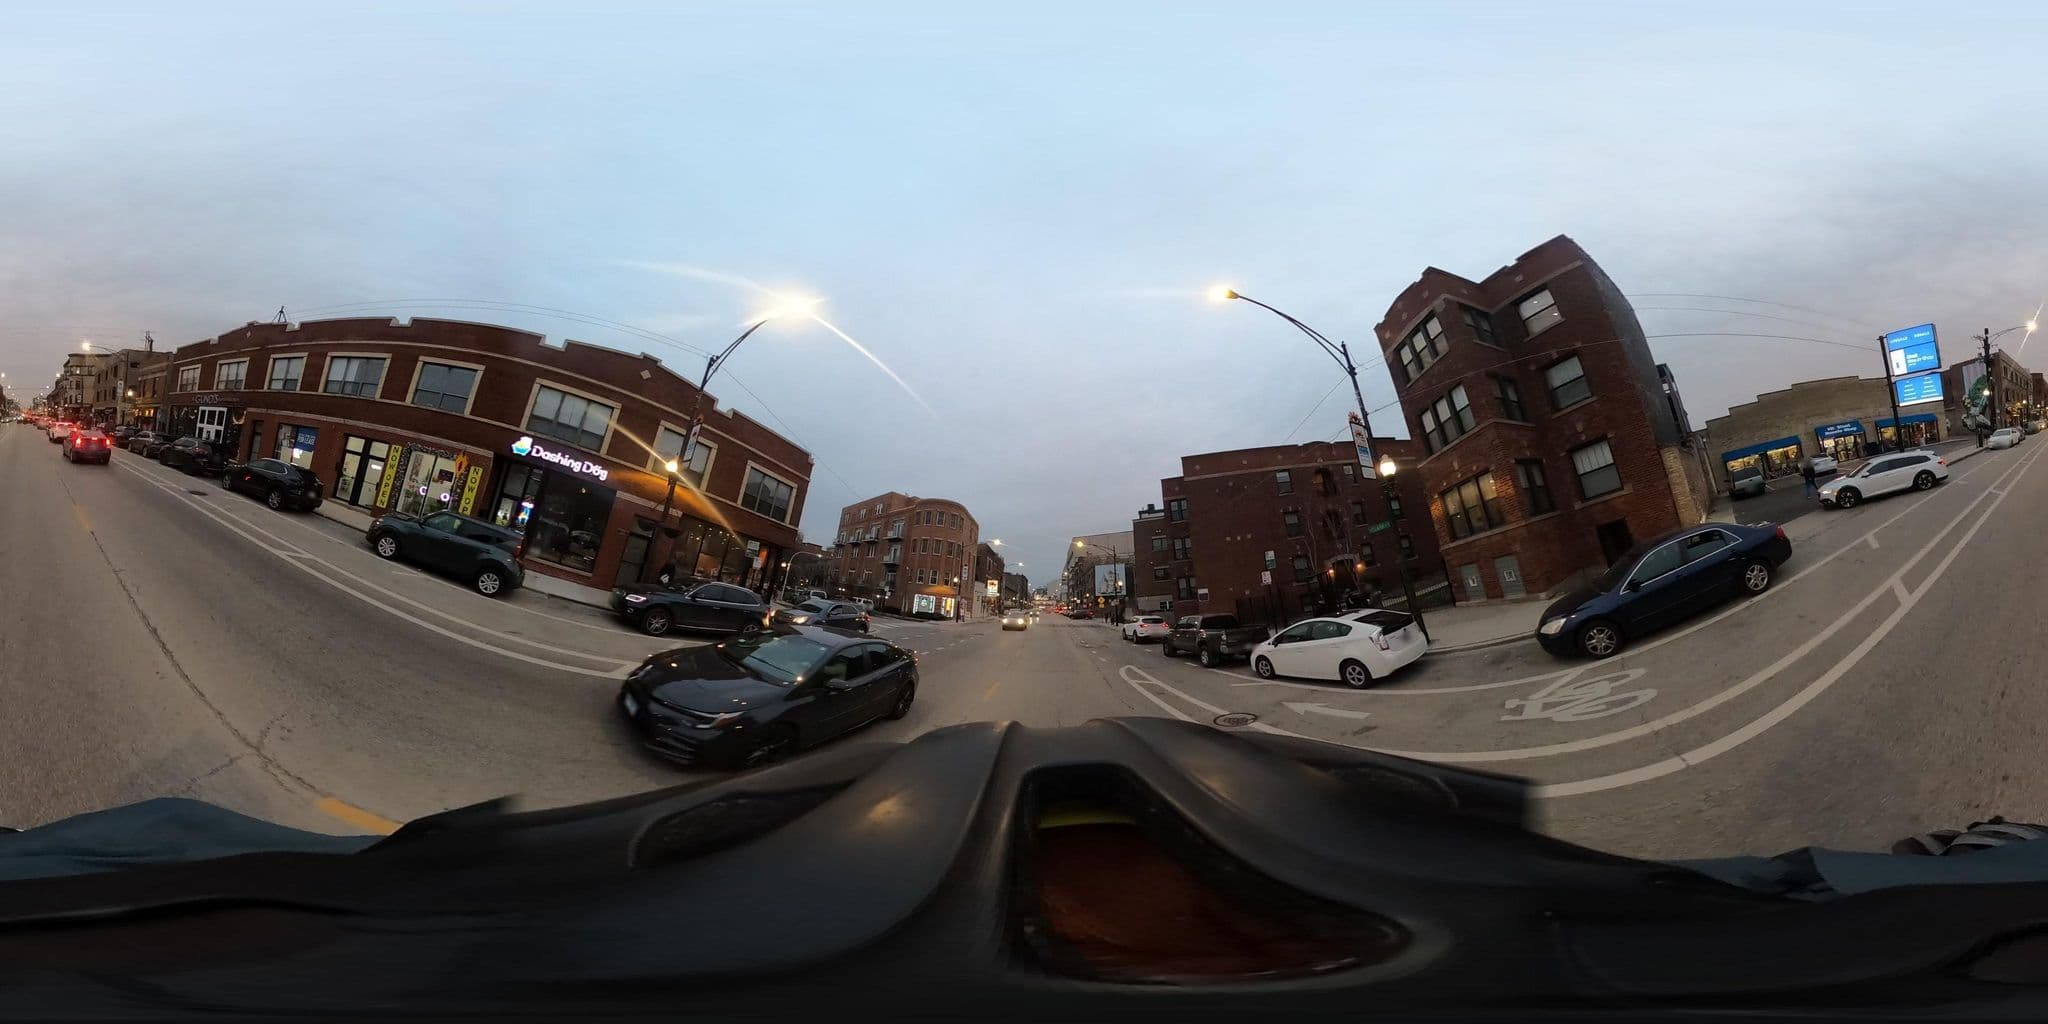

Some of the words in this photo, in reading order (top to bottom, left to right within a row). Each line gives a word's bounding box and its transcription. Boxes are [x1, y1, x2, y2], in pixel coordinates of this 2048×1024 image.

[390, 446, 401, 470] NOW
[531, 445, 582, 472] Dashing
[380, 474, 392, 506] OPEN
[467, 467, 480, 494] NOW
